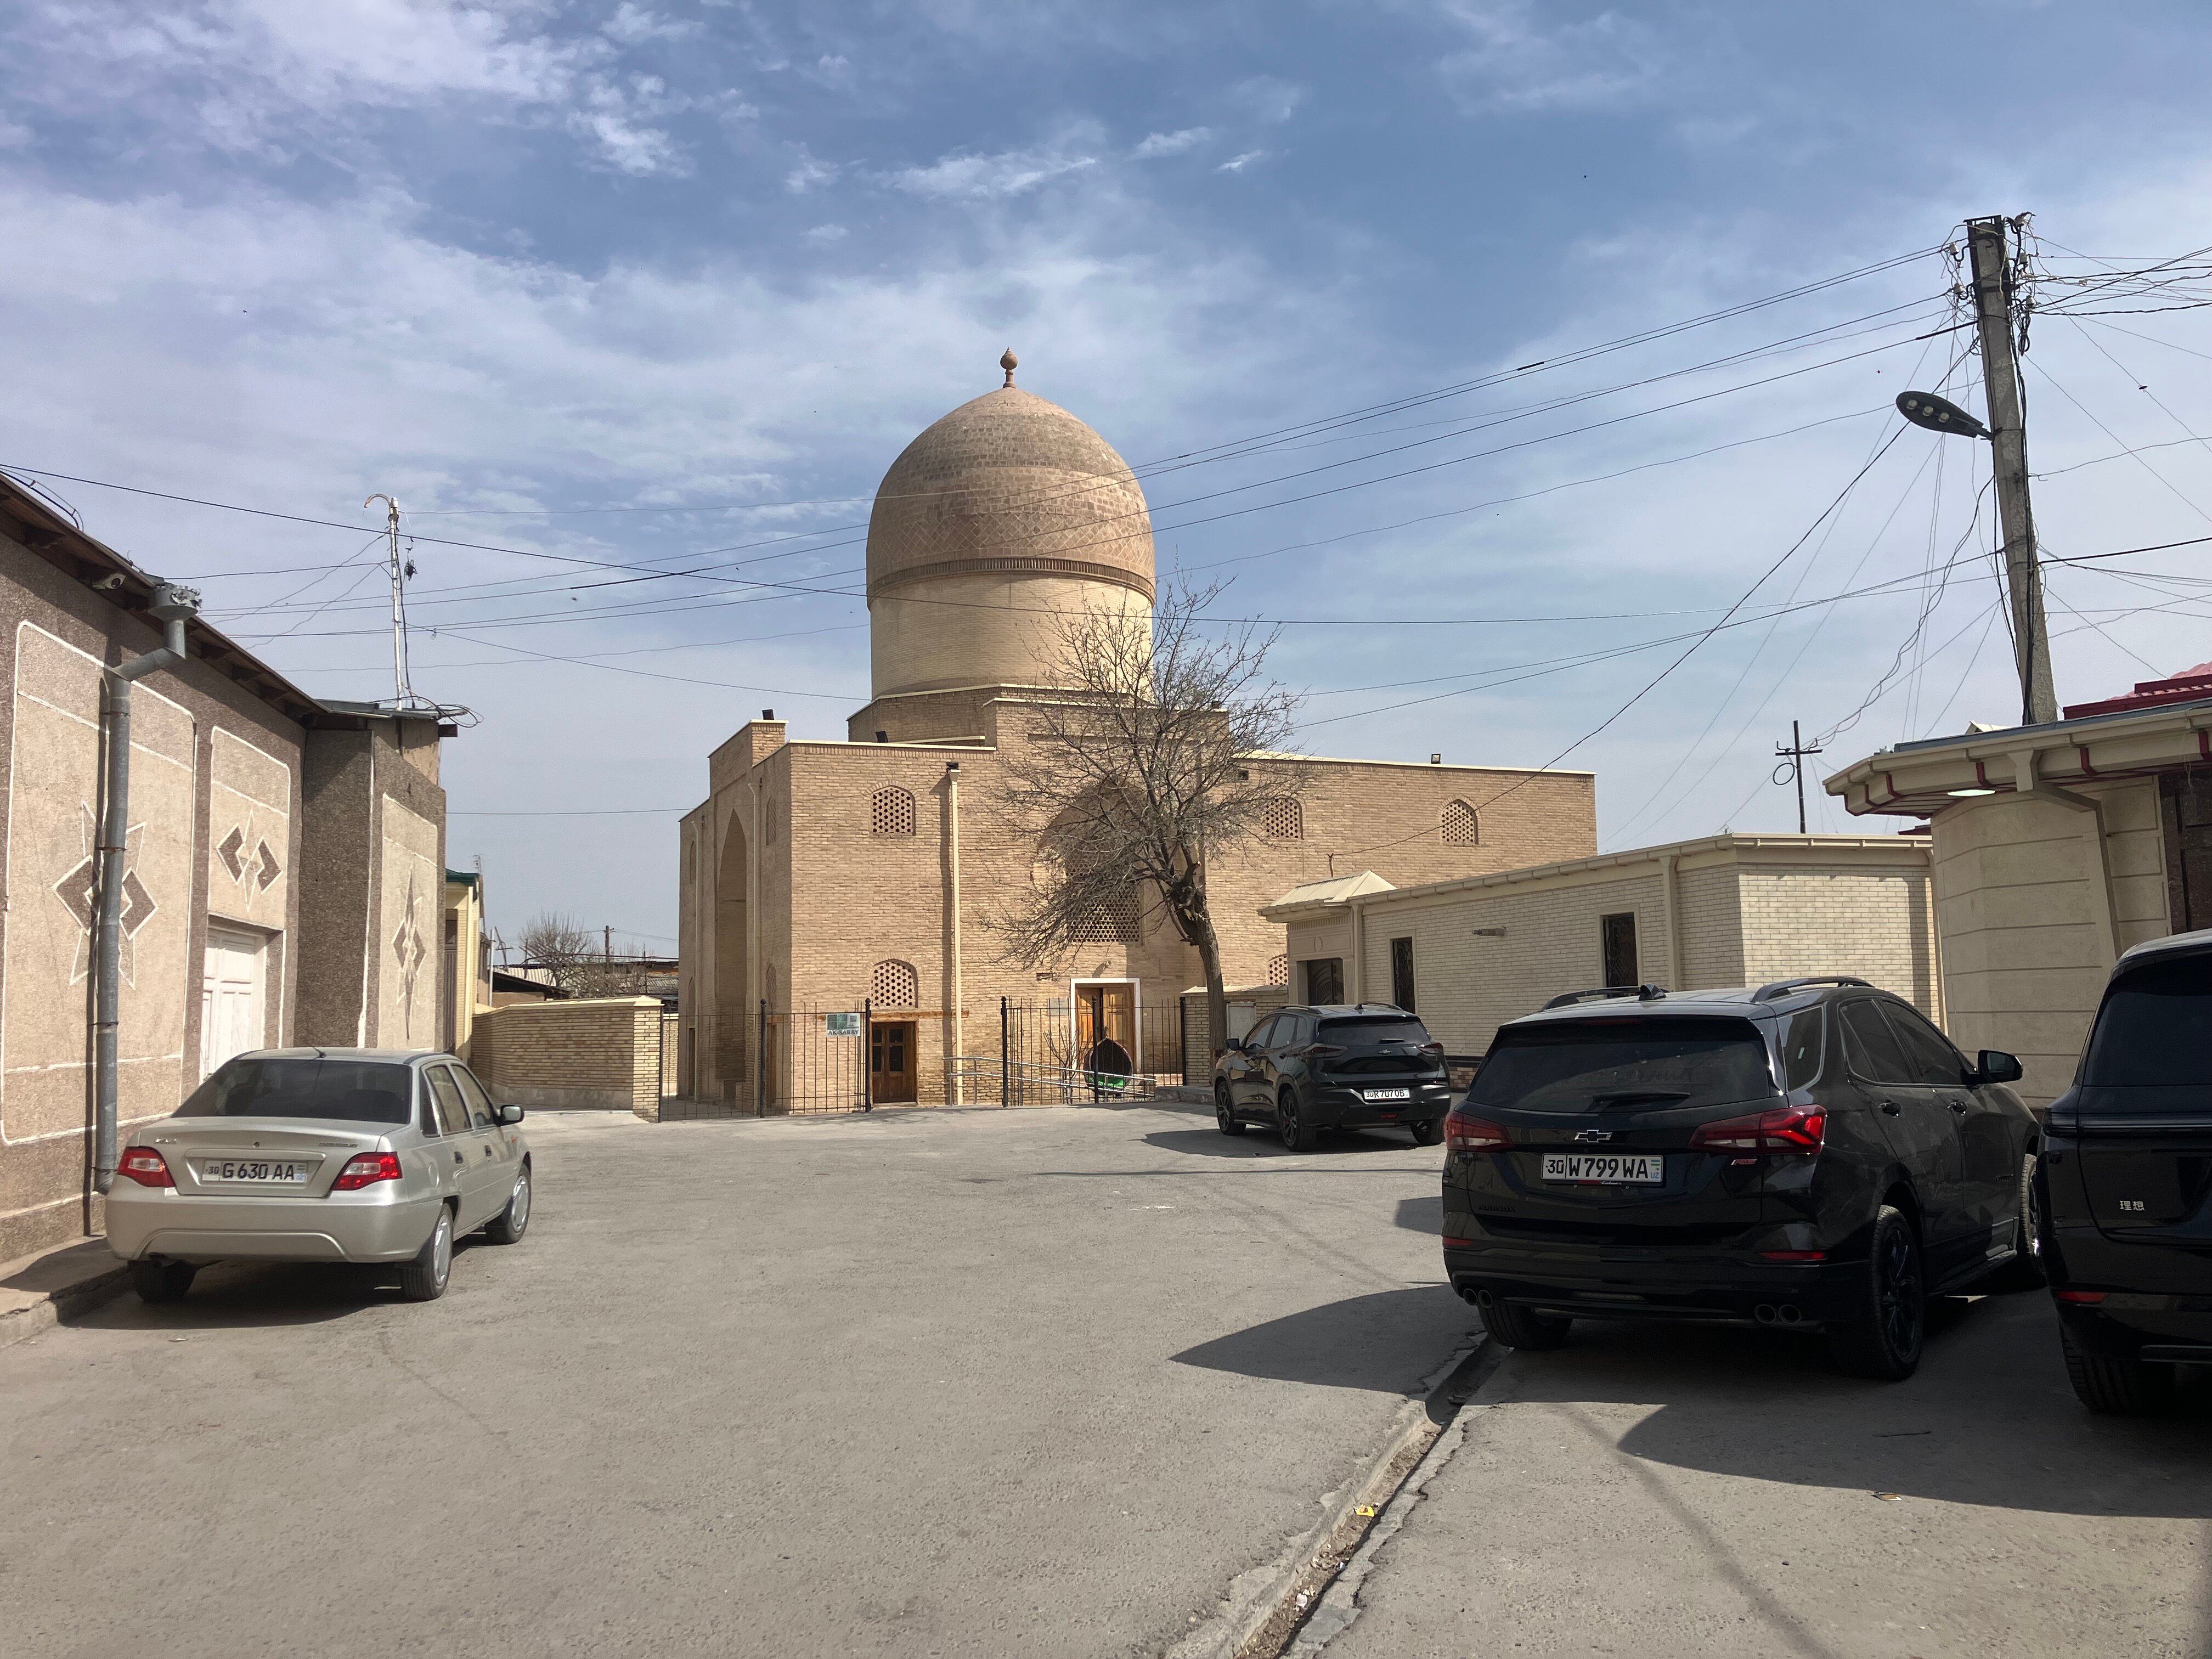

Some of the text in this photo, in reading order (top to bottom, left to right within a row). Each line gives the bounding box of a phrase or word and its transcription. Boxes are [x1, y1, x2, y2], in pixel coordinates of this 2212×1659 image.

[208, 1166, 219, 1175] 30
[222, 1163, 234, 1178] G
[238, 1163, 268, 1180] 630
[272, 1164, 294, 1181] AA
[1548, 1158, 1648, 1178] 30 W 799 WA
[2119, 1200, 2145, 1211] 理想
